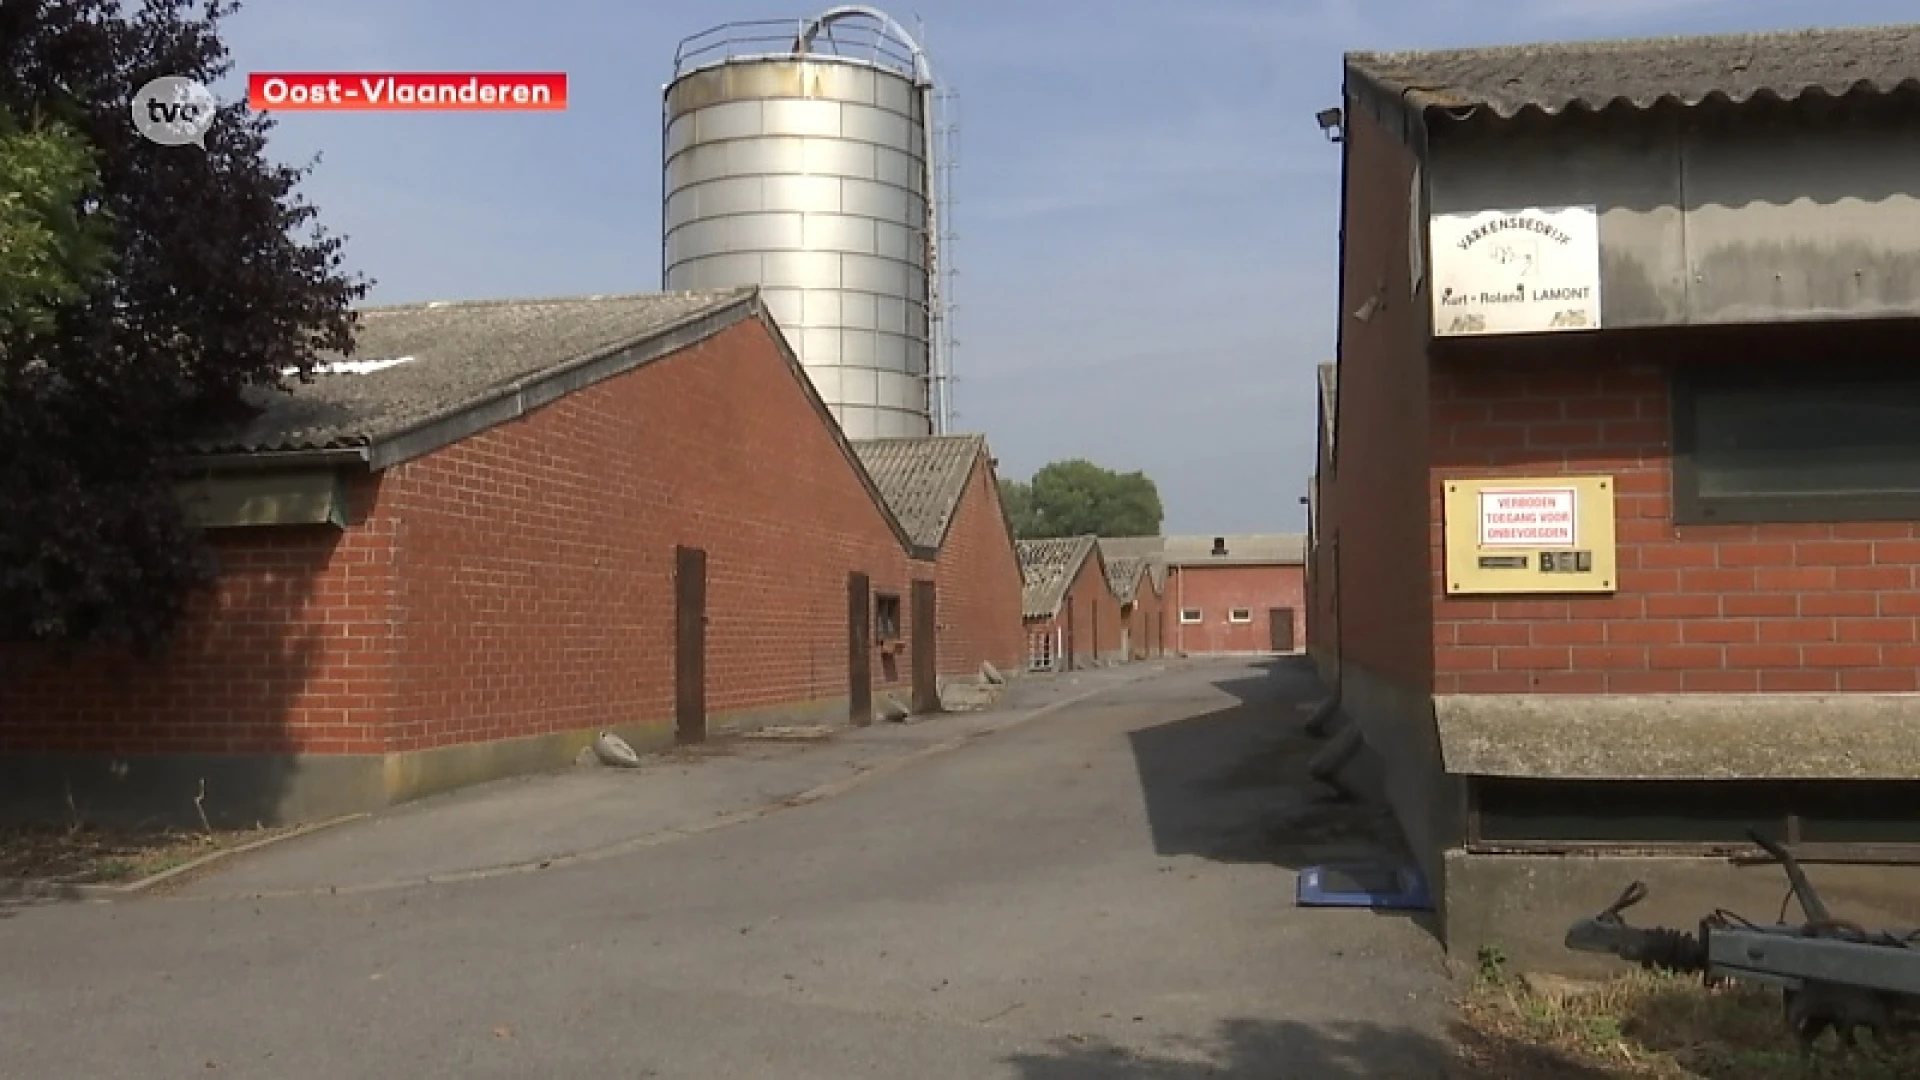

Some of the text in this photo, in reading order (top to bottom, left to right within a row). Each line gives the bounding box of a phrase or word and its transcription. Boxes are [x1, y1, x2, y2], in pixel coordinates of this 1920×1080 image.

[1480, 289, 1525, 305] Roland
[1532, 287, 1591, 302] LAMONT
[1498, 496, 1557, 509] VERBODEN
[1486, 511, 1570, 524] TOEGANG VOOR
[1487, 527, 1568, 539] ONBEVOEGDEN
[1540, 551, 1592, 572] BEL
